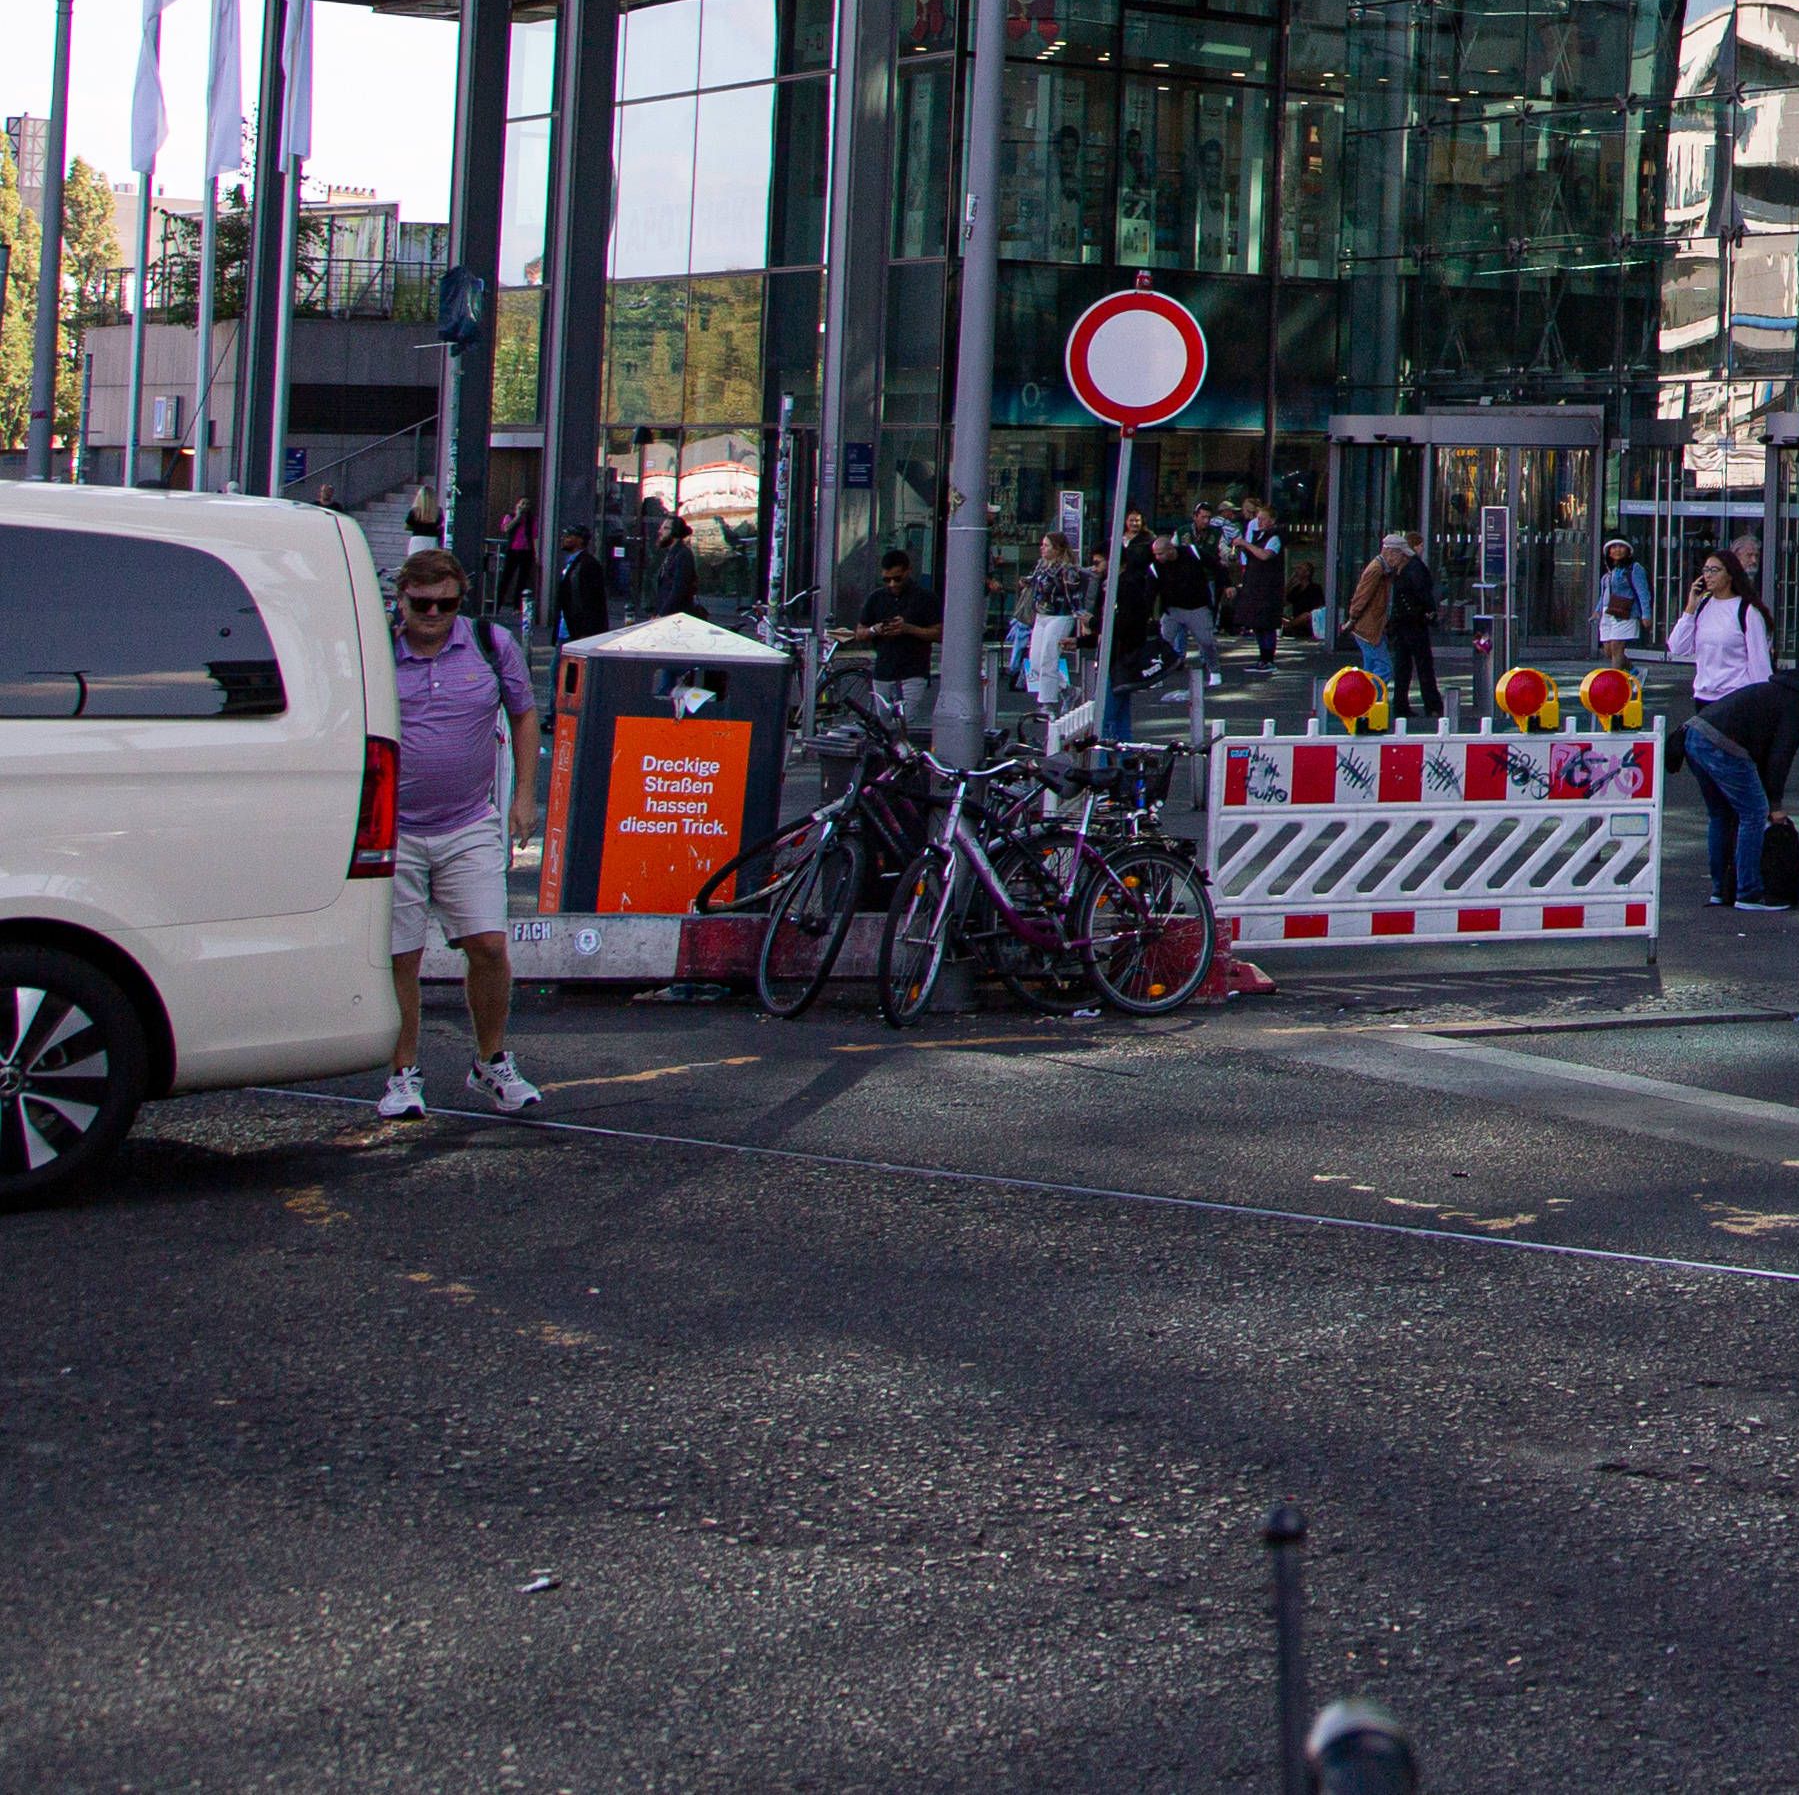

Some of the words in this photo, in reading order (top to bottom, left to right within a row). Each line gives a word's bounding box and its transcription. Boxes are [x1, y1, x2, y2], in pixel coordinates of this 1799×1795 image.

[642, 755, 721, 775] Dreckige
[644, 776, 714, 795] Straßen
[645, 796, 708, 814] hassen
[619, 816, 678, 834] diesen
[682, 818, 729, 836] Trick.
[514, 922, 551, 942] FACH
